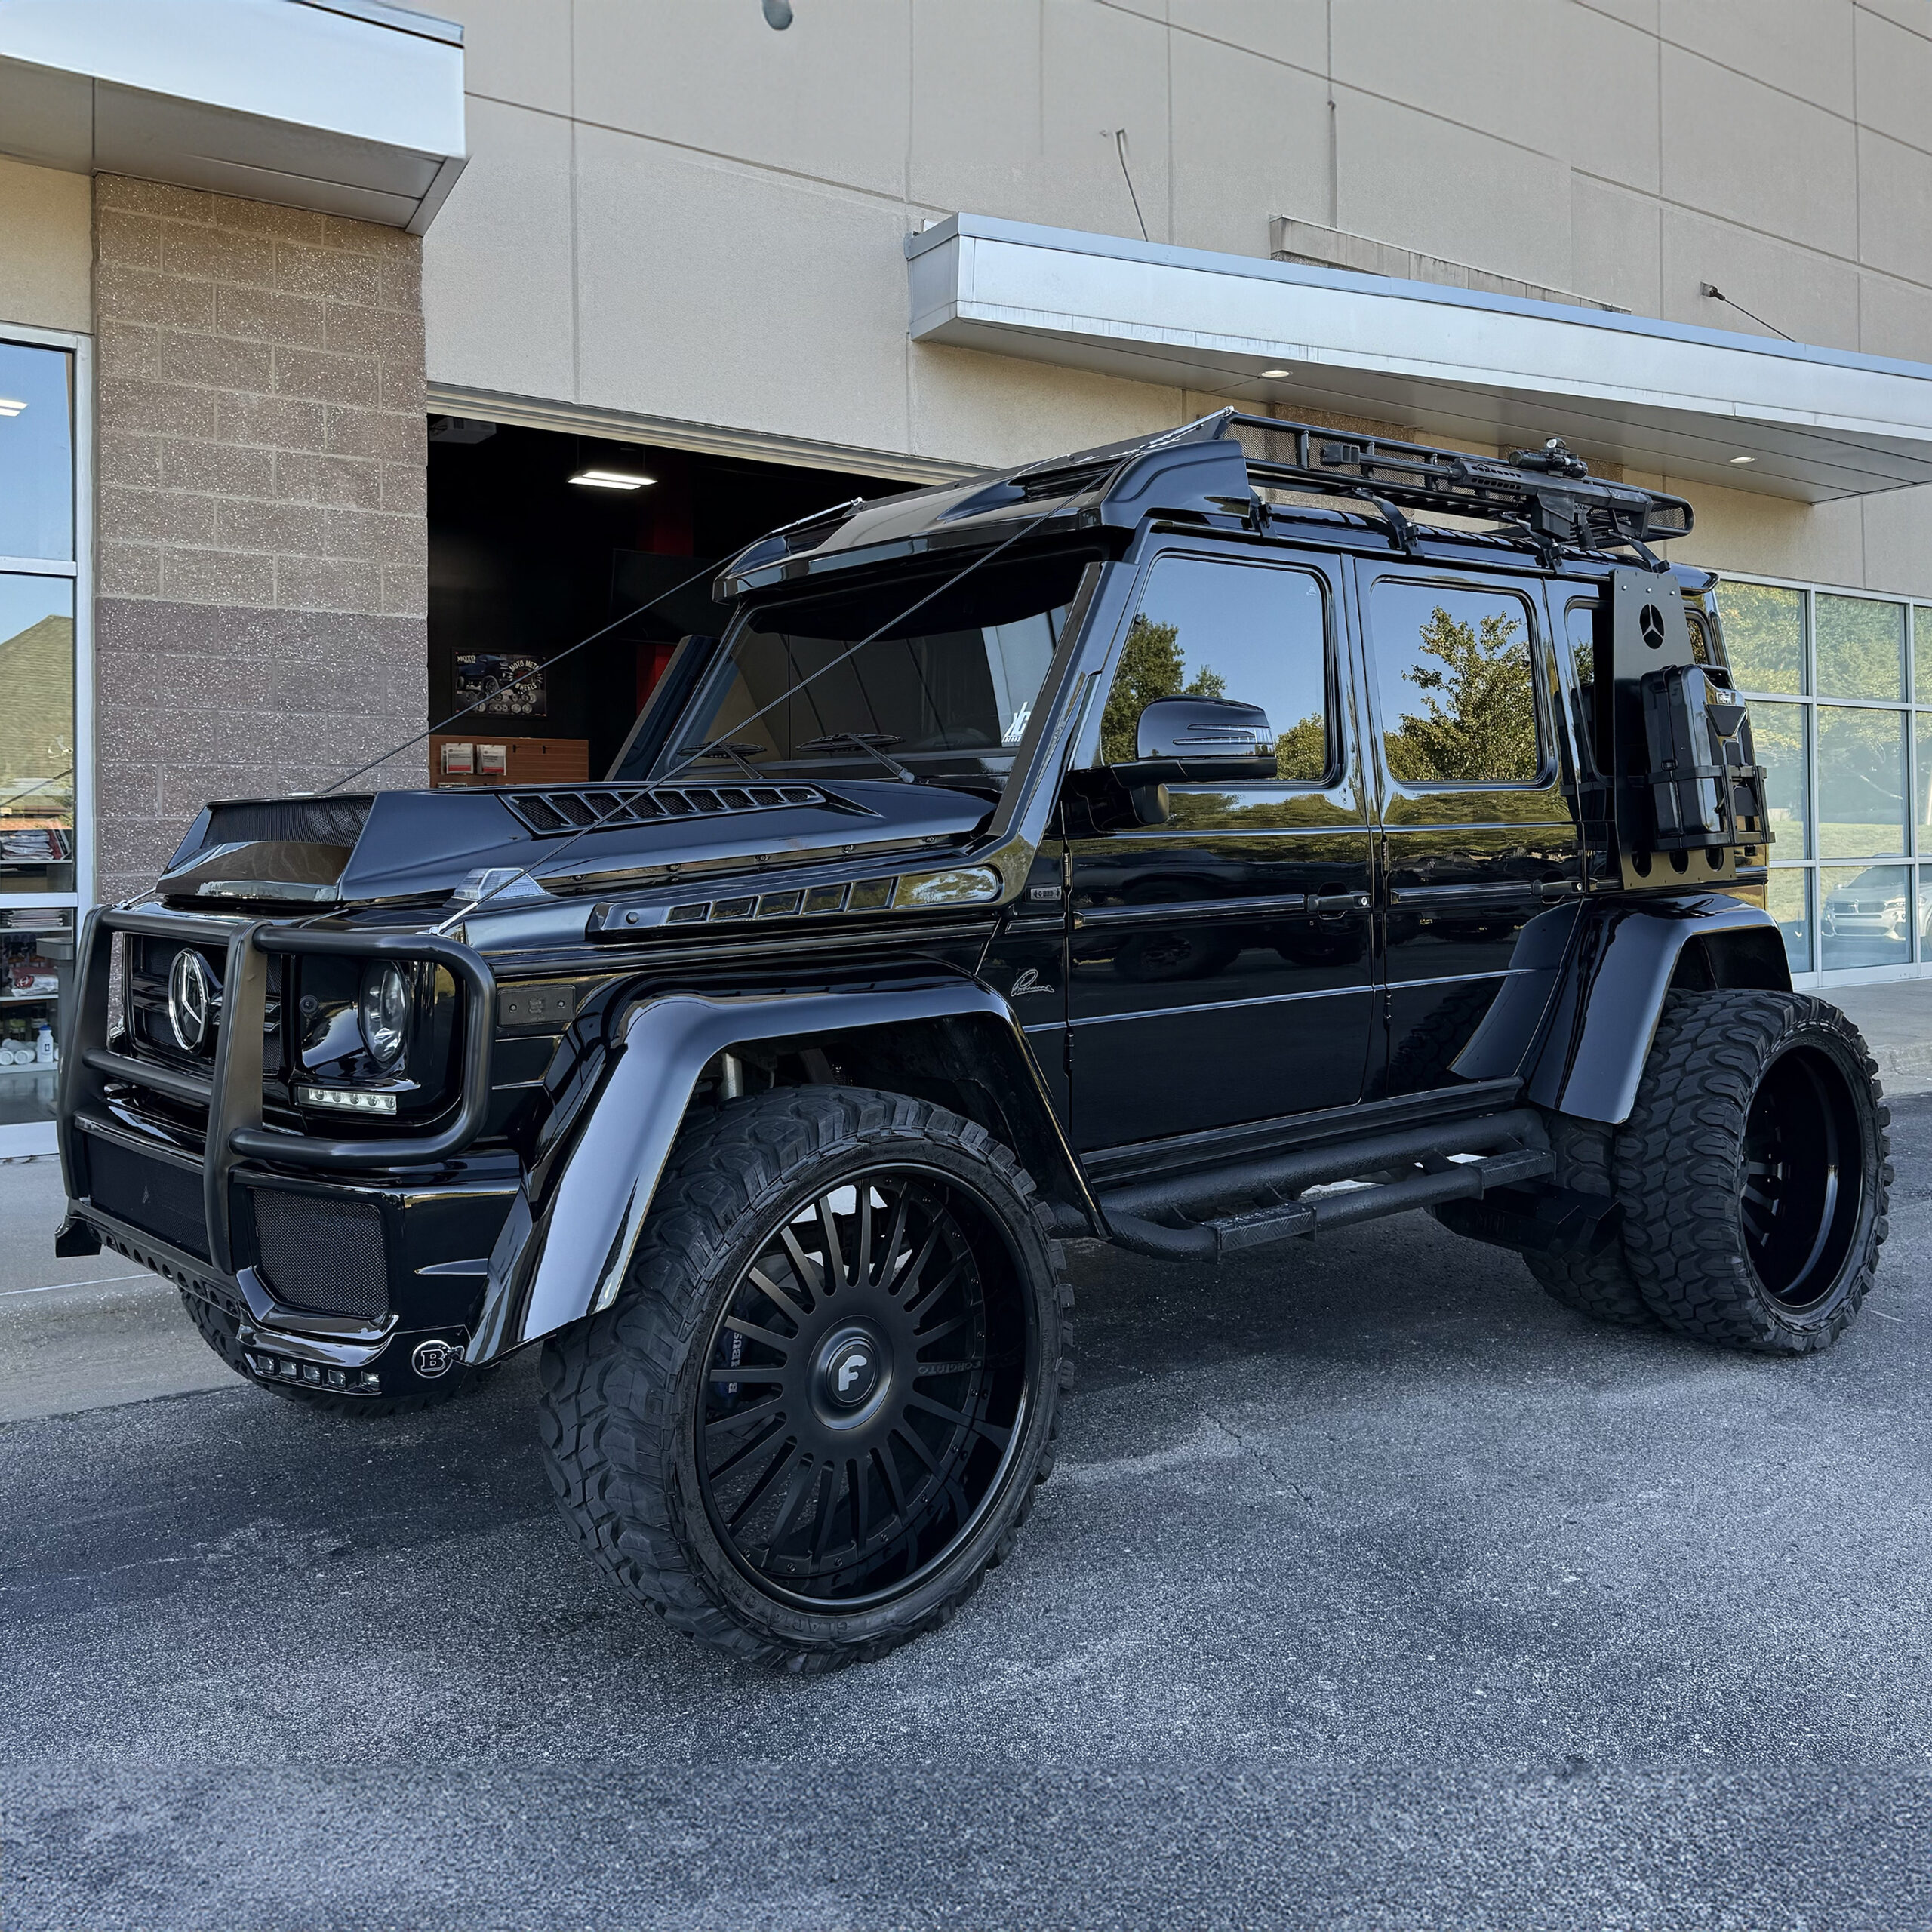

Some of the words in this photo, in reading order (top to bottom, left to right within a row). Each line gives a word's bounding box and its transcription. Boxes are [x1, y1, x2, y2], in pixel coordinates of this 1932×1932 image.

[509, 660, 525, 672] MOTO
[515, 681, 537, 691] WHEELS
[420, 1349, 446, 1372] B
[728, 1332, 743, 1394] BABUS
[917, 1360, 982, 1374] FORGIATO
[838, 1354, 868, 1392] F
